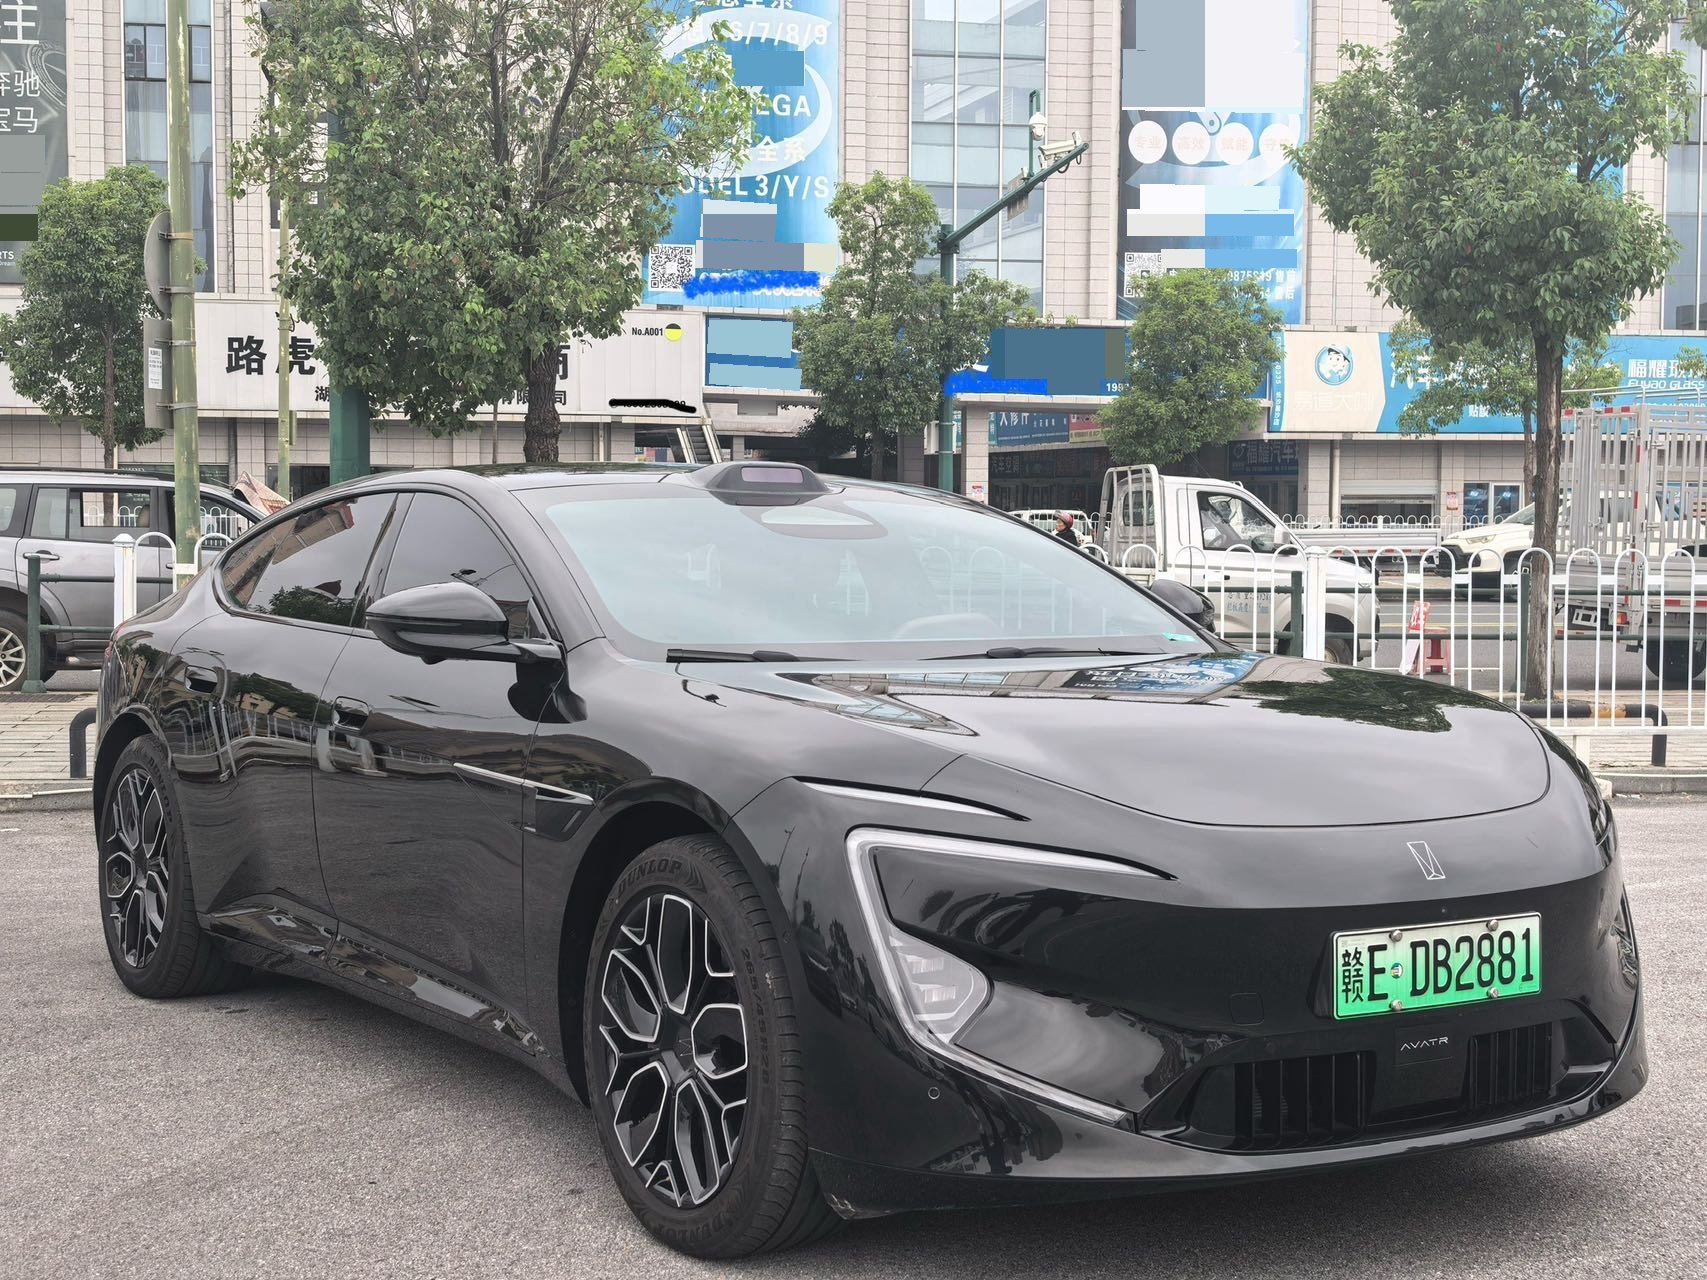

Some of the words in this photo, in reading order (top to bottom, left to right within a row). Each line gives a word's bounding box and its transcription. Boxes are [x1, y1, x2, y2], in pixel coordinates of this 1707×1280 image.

[0, 250, 15, 260] TS
[616, 857, 683, 900] DUNLOP
[1410, 927, 1534, 997] DB2881
[1400, 1036, 1449, 1051] AVATR
